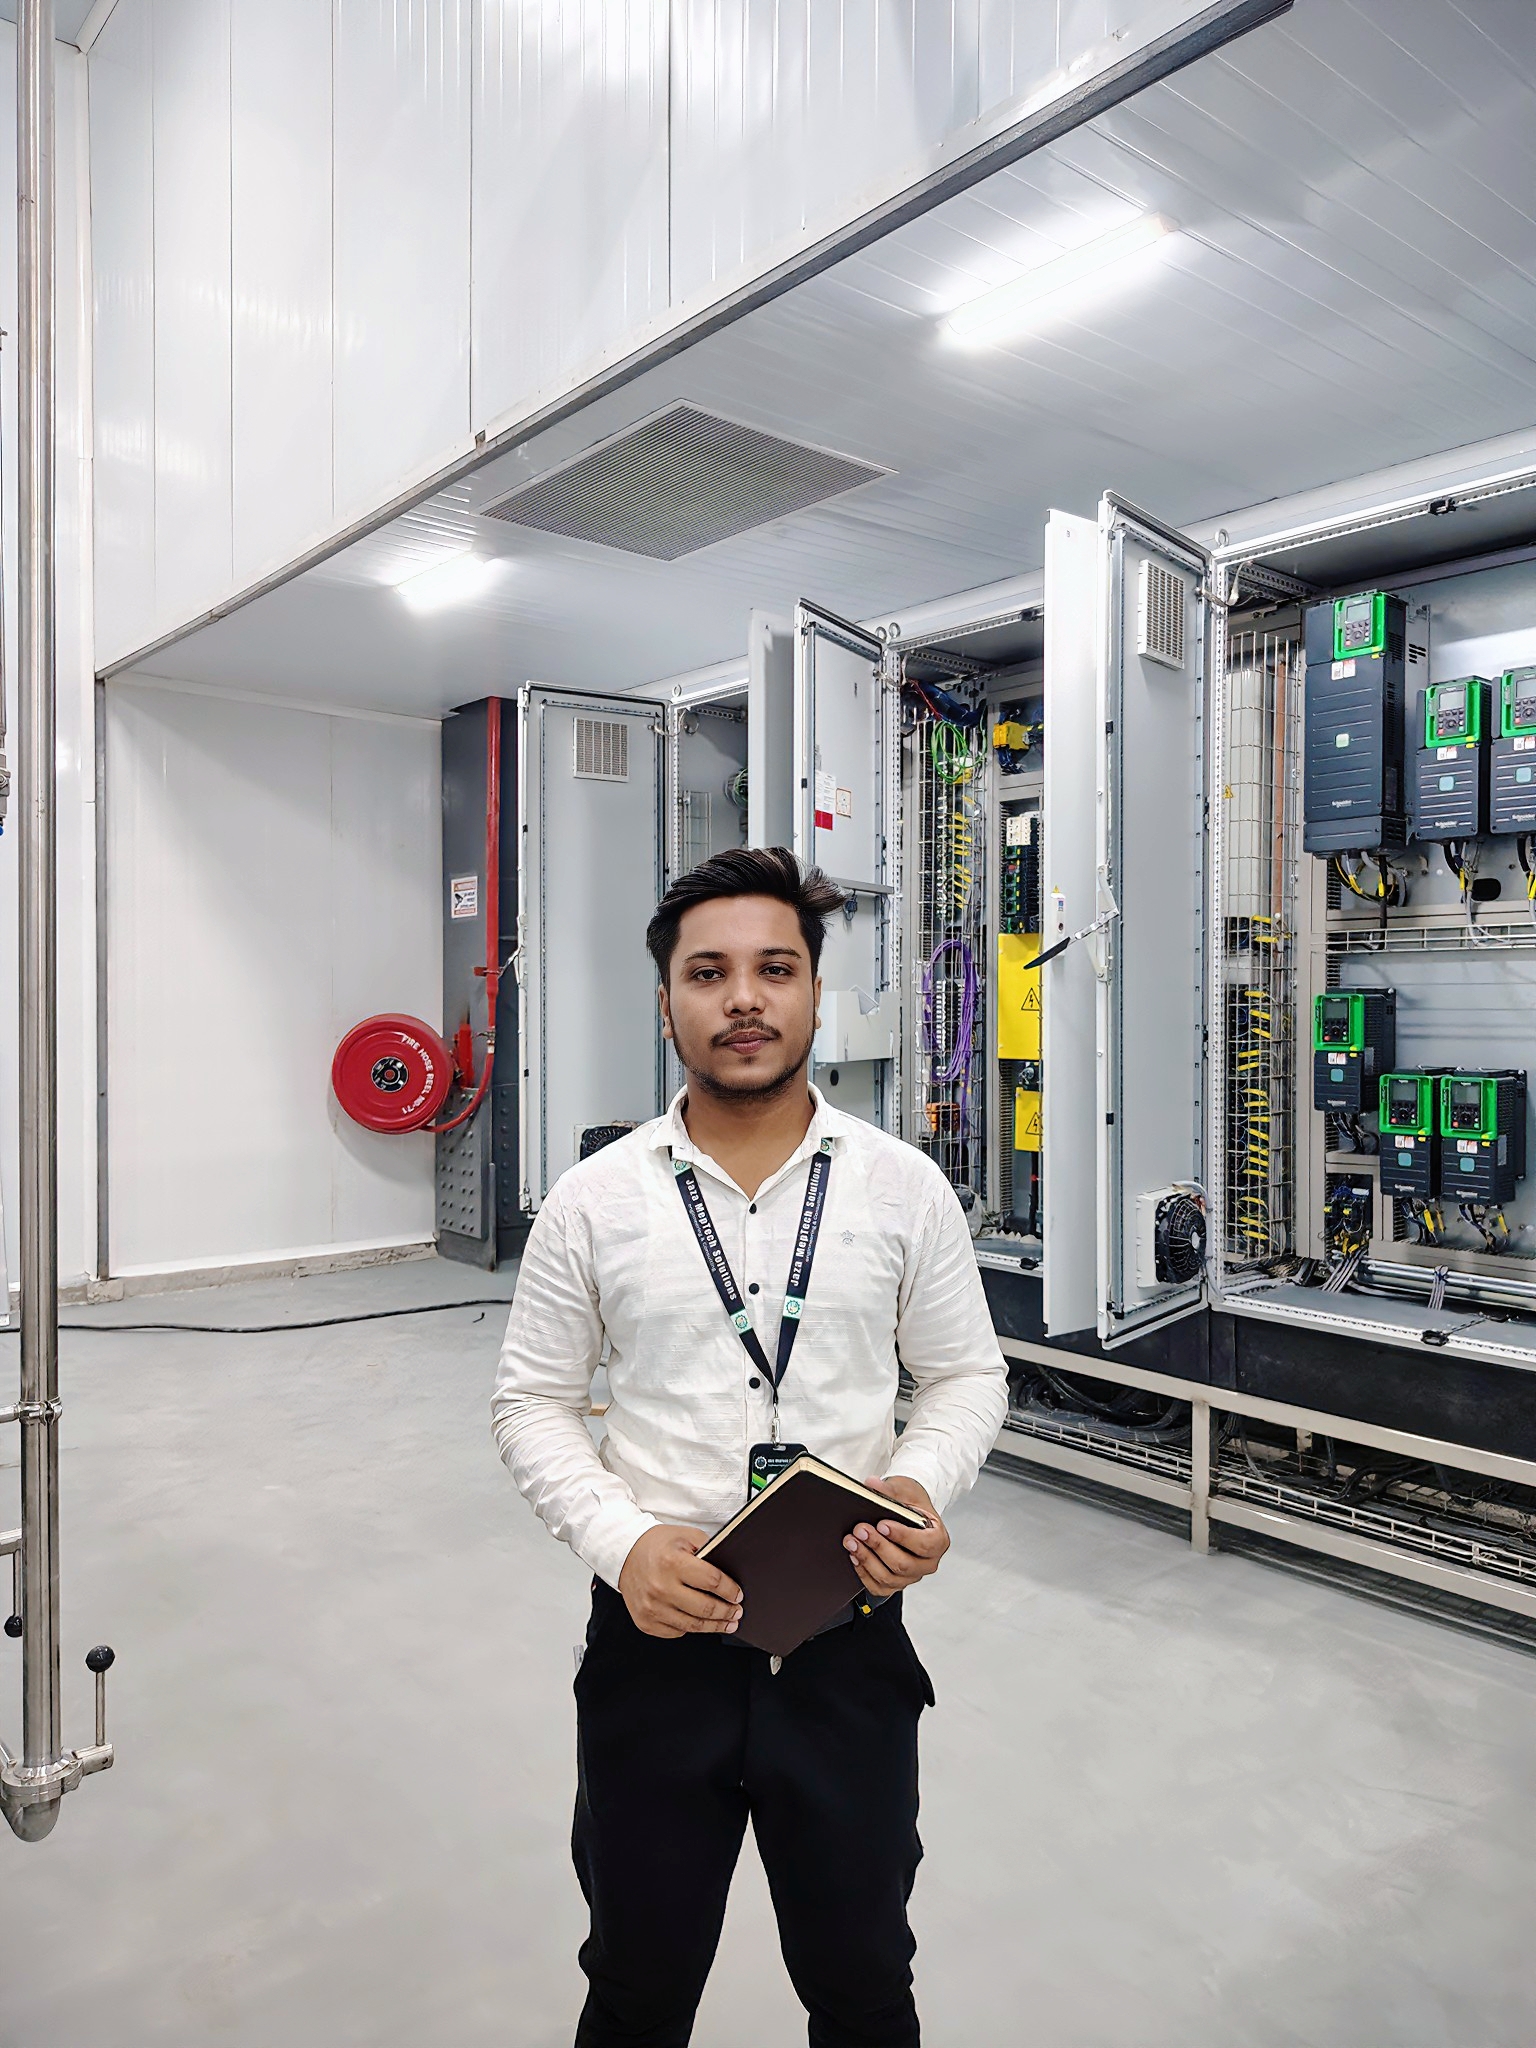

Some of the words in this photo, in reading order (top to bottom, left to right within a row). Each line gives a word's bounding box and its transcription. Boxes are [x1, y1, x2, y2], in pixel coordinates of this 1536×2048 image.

[401, 1034, 420, 1050] FIRE
[418, 1048, 433, 1071] HOSE
[421, 1073, 434, 1094] REEL
[790, 1261, 802, 1287] Jaza
[796, 1210, 813, 1257] MepTech
[806, 1161, 822, 1208] Solutions
[685, 1179, 700, 1201] Jaza
[695, 1202, 717, 1248] MepTech
[712, 1249, 737, 1301] Solutions
